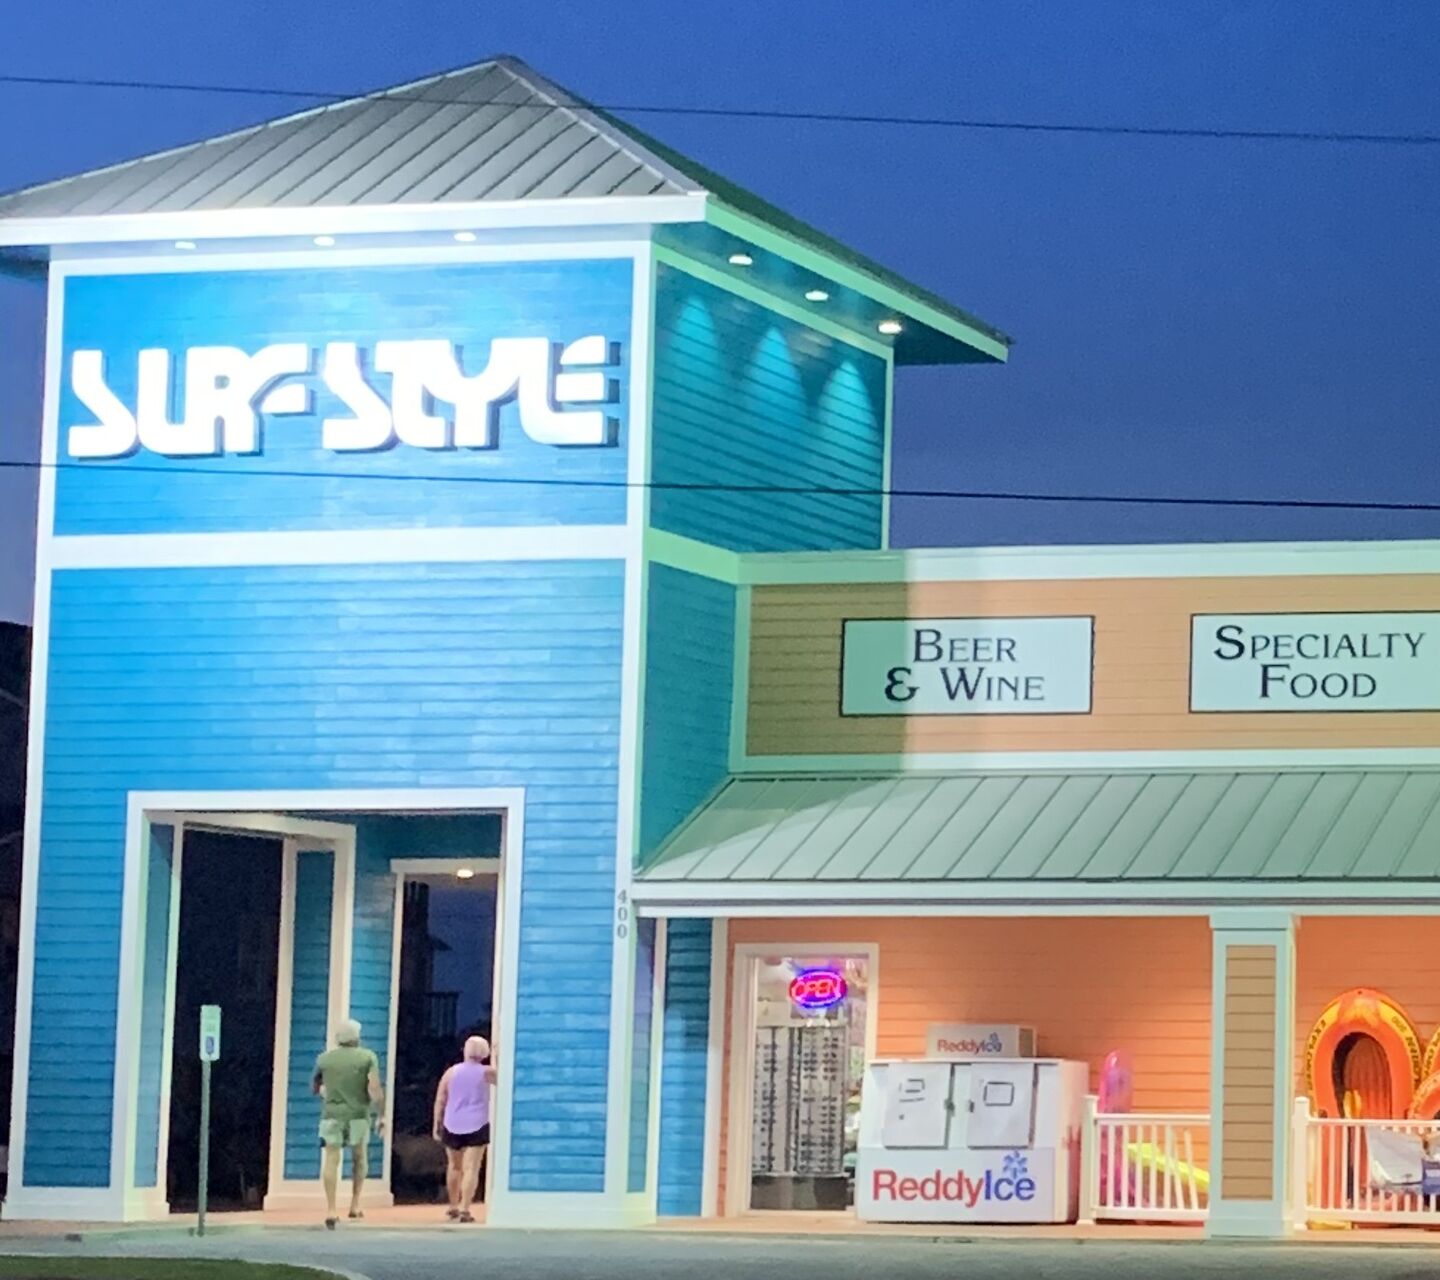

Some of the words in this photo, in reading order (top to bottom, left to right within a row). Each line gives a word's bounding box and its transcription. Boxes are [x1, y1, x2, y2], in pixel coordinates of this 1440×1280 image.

[68, 342, 312, 459] SURF
[321, 335, 618, 452] STYLE
[912, 628, 1018, 663] BEER
[1213, 624, 1426, 660] SPECIALTY
[884, 666, 920, 702] &
[939, 666, 1046, 701] WINE
[1259, 663, 1377, 699] FOOD
[791, 978, 842, 1001] OPEN
[872, 1168, 1037, 1209] ReddyIce
